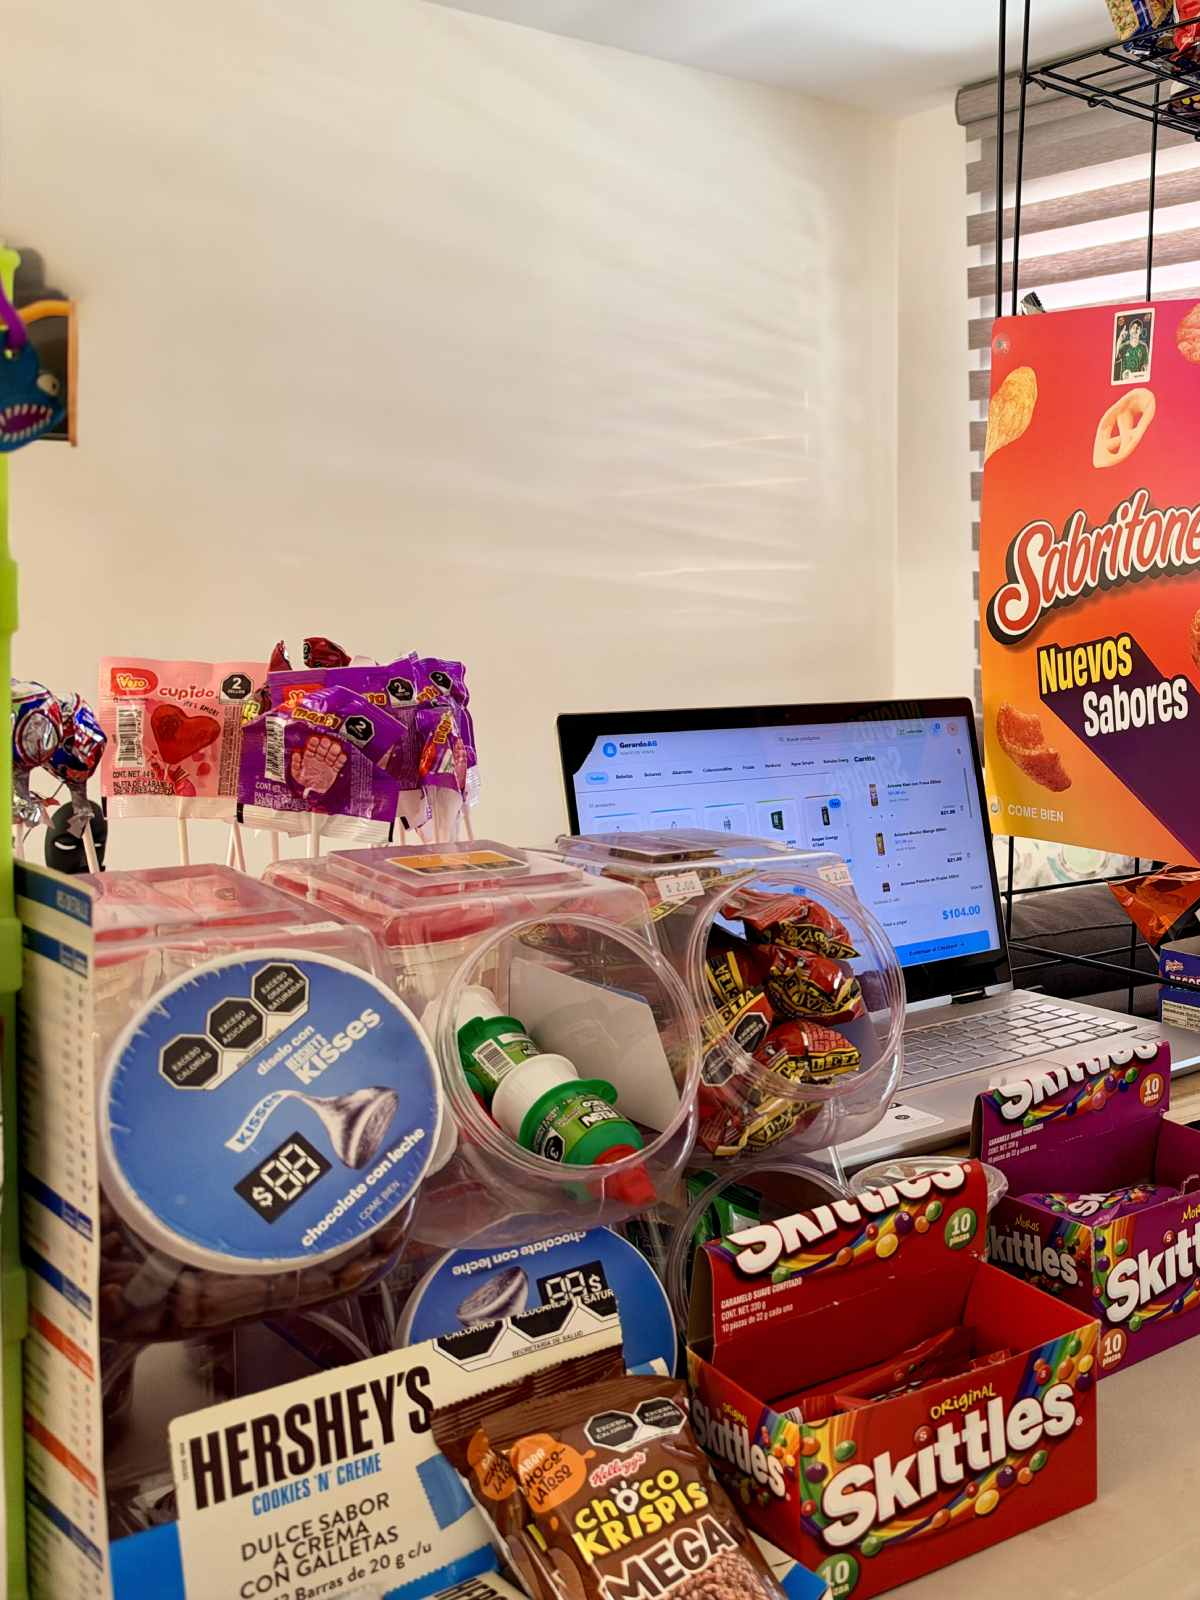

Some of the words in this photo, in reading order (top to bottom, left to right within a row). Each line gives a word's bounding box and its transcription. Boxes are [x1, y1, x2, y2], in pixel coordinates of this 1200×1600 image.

[1040, 635, 1133, 694] Nuevos
[118, 675, 147, 689] Vero
[159, 686, 215, 700] cupido
[231, 677, 242, 689] 2
[1083, 678, 1188, 737] Sabores
[358, 721, 366, 733] 2
[1008, 804, 1038, 819] COME
[1040, 808, 1064, 823] BIEN
[942, 904, 981, 920] $104.00
[261, 971, 288, 994] EXCESO
[267, 977, 295, 1000] GRASAS
[218, 1009, 247, 1034] EXCESO
[292, 1025, 315, 1047] con
[297, 1008, 381, 1085] Kisses
[171, 1046, 200, 1072] EXCESO
[1144, 1077, 1160, 1094] 10
[301, 1182, 368, 1247] chocolate
[365, 1161, 392, 1188] con
[388, 1127, 426, 1166] leche
[950, 1212, 972, 1237] 10
[520, 1231, 587, 1256] chocolate
[452, 1259, 492, 1277] leche
[493, 1248, 519, 1267] con
[721, 1292, 752, 1309] CARAMELO
[753, 1286, 771, 1300] SUAVE
[1104, 1333, 1123, 1356] 10
[189, 1366, 434, 1511] HERSHEY'S
[690, 1400, 787, 1499] Skittles
[589, 1451, 646, 1488] Kellogg's
[822, 1382, 1077, 1548] Skittles
[252, 1476, 312, 1517] COOKIES
[336, 1453, 383, 1484] CREME
[240, 1519, 314, 1563] DULCE
[319, 1491, 391, 1534] SABOR
[571, 1481, 709, 1565] KRISPIS
[272, 1551, 289, 1570] A
[292, 1521, 372, 1562] CREMA
[598, 1513, 739, 1600] MEGA
[239, 1568, 290, 1600] CON
[296, 1525, 400, 1577] GALLETAS
[294, 1576, 345, 1600] Barras
[347, 1566, 367, 1584] de
[370, 1554, 392, 1576] 20
[395, 1551, 407, 1569] g
[408, 1540, 433, 1562] c/u
